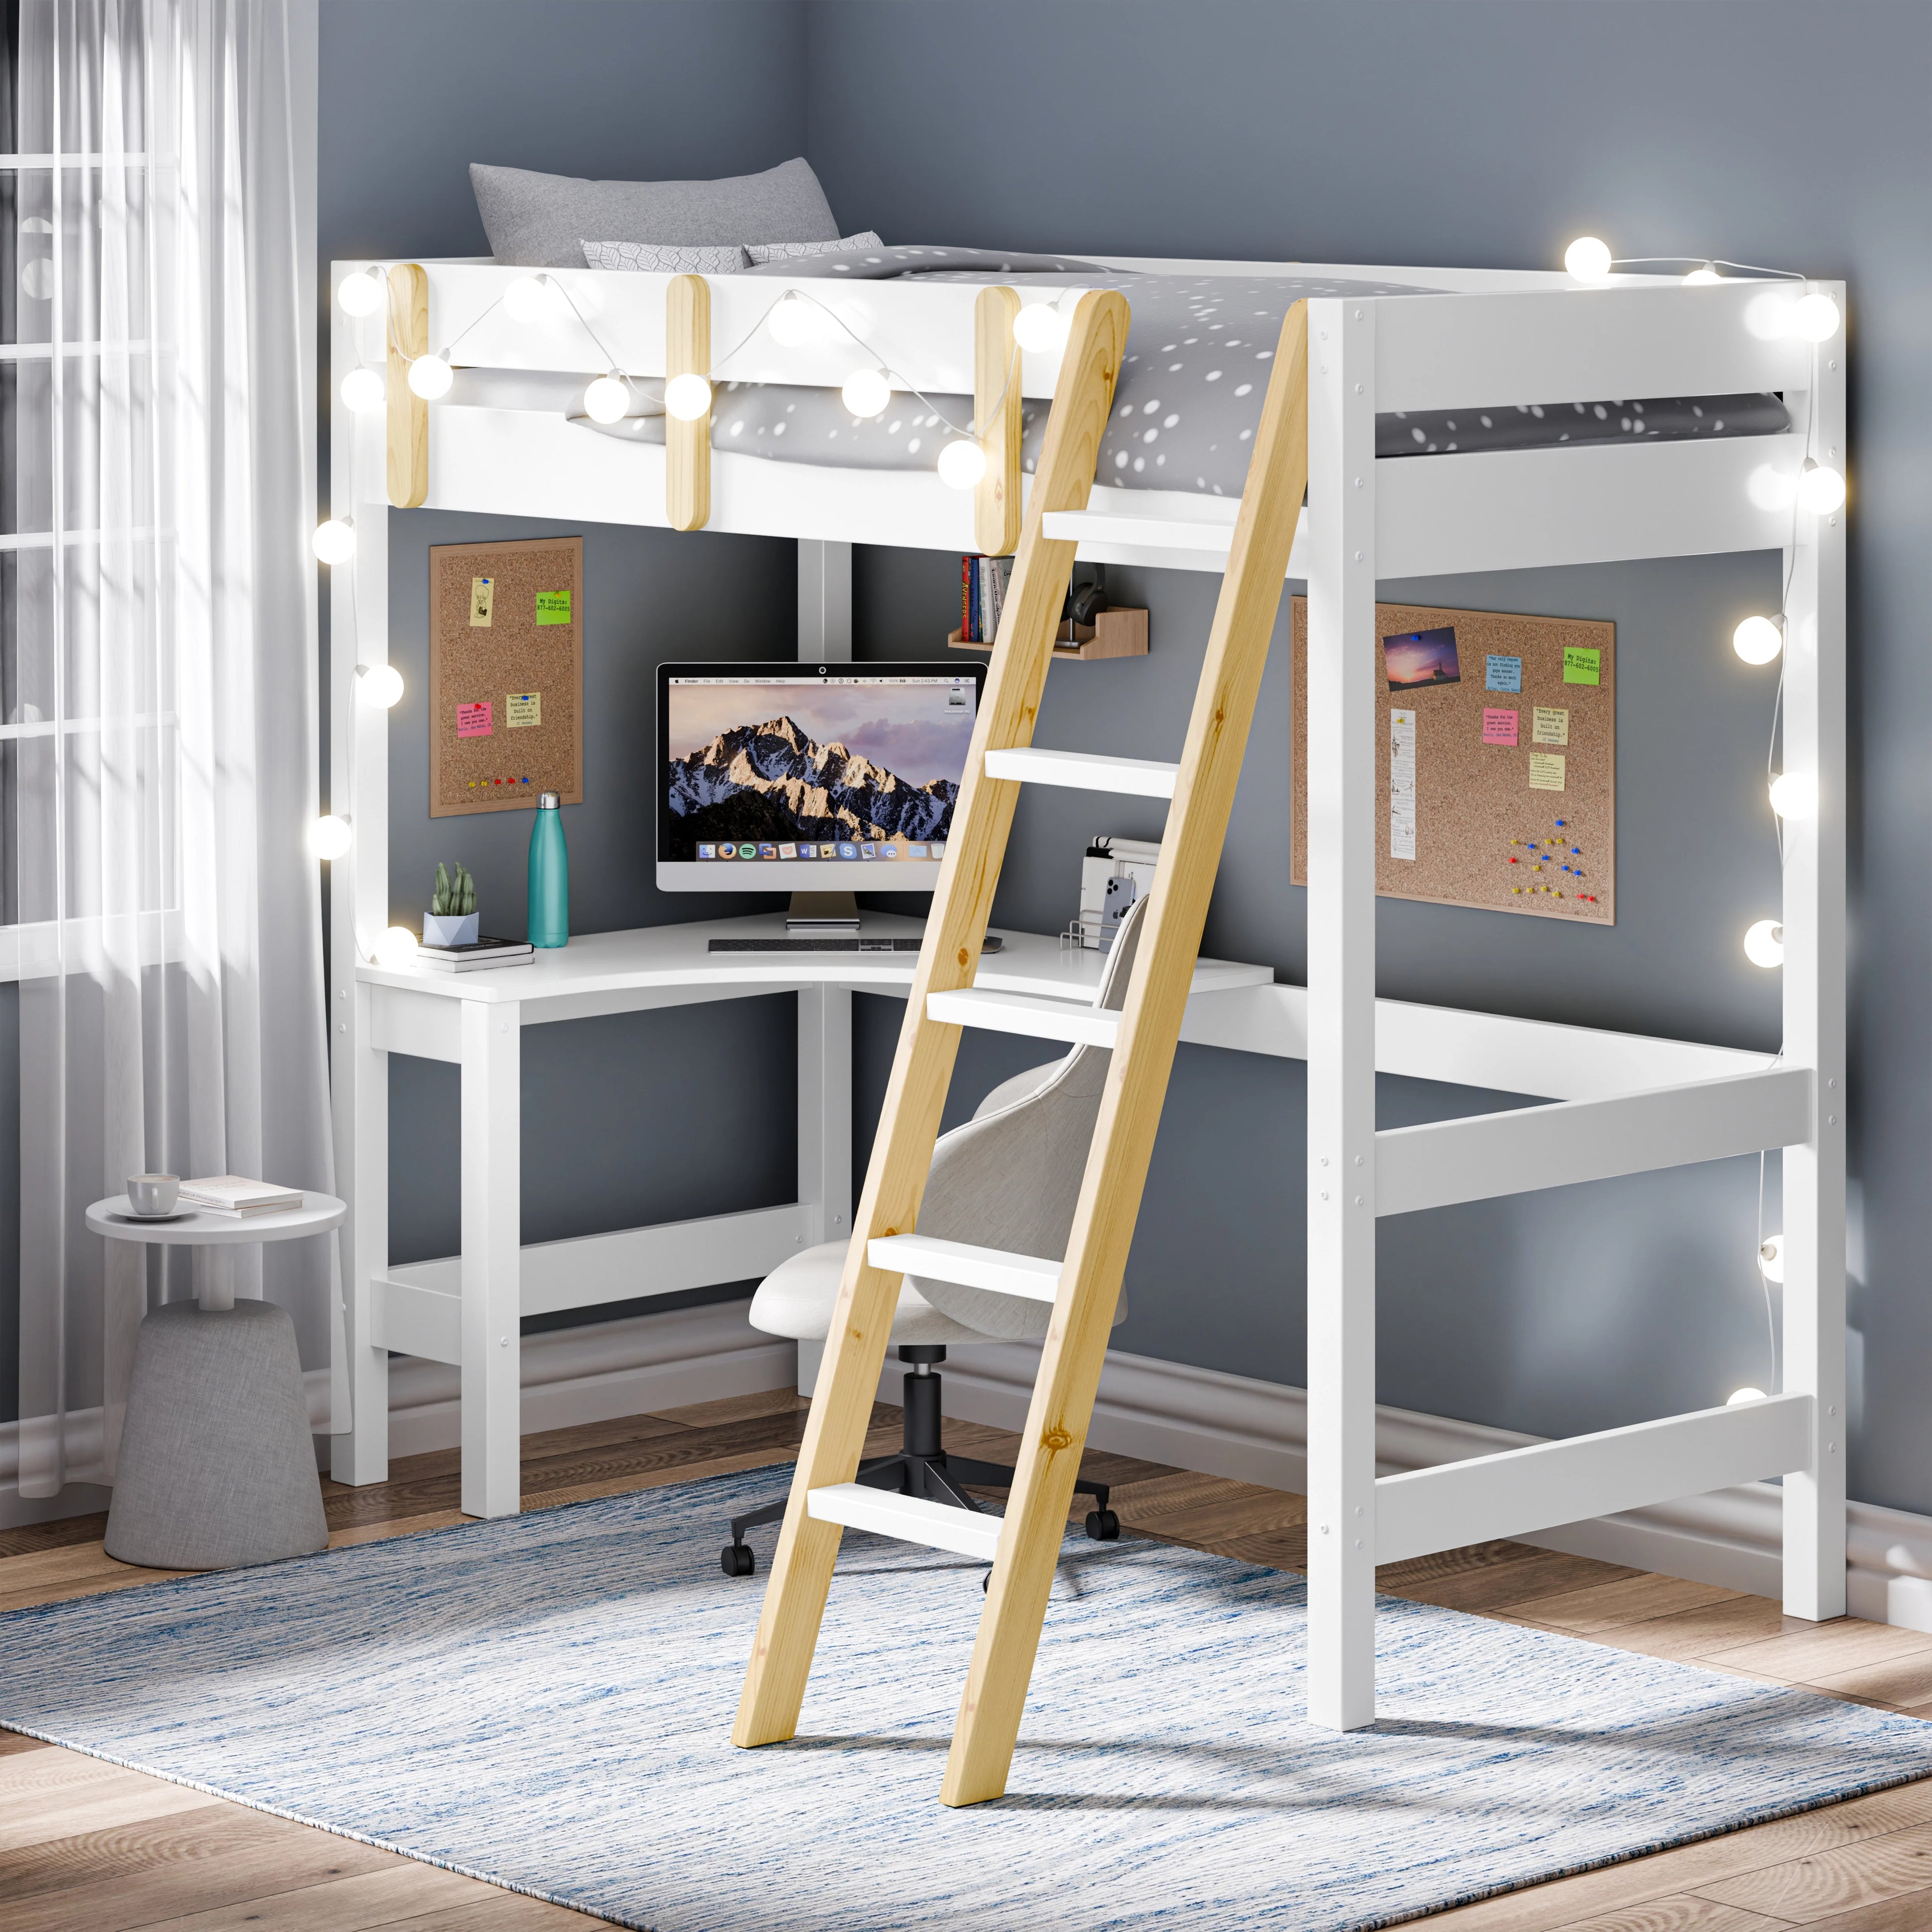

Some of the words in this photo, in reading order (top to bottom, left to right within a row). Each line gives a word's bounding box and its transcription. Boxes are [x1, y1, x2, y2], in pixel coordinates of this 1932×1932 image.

[1576, 656, 1596, 665] Digits:
[1564, 660, 1598, 673] 877-602-6005
[843, 846, 853, 856] S
[196, 1194, 226, 1205] Photography
